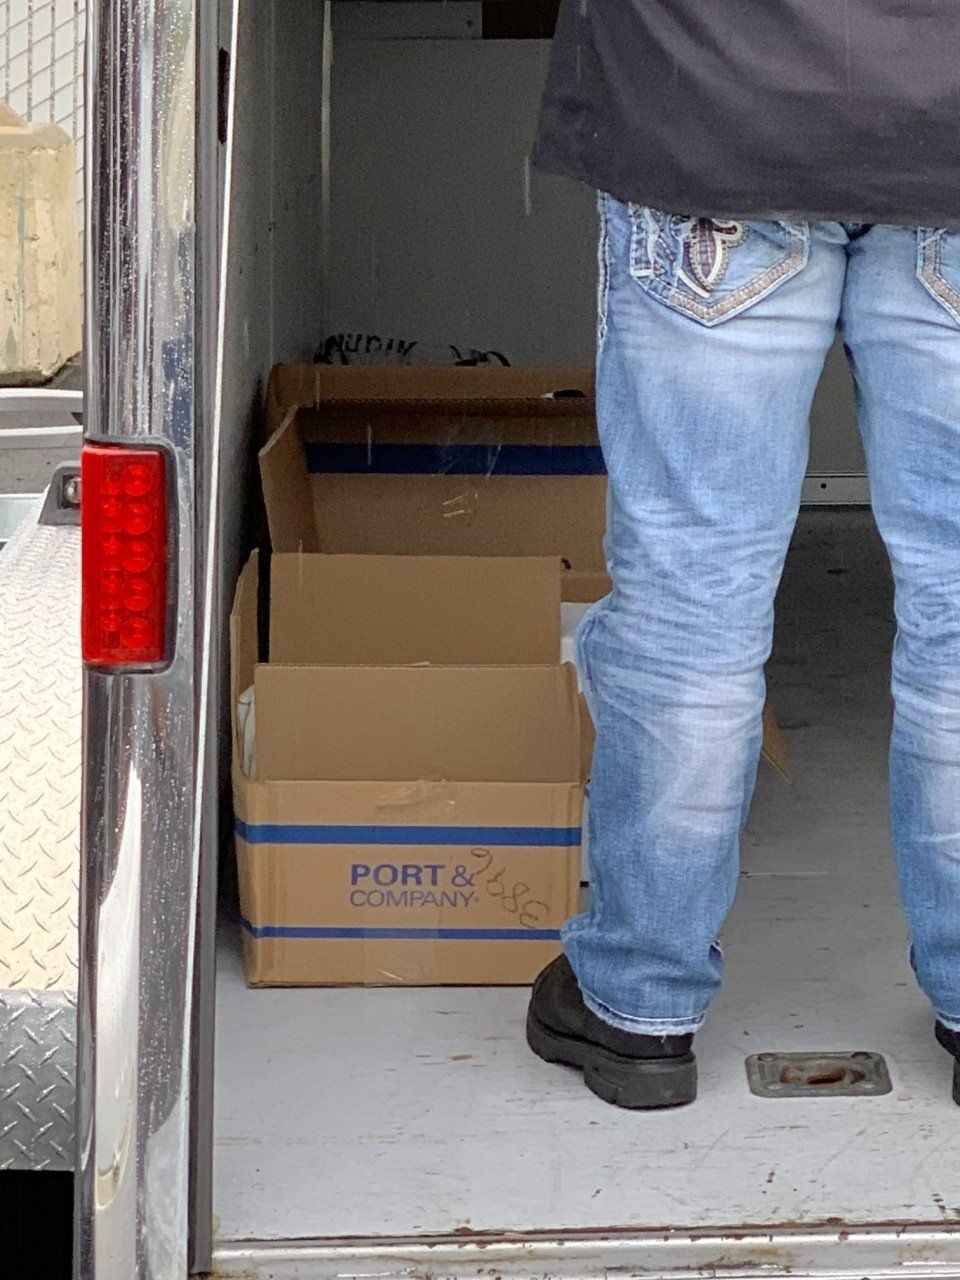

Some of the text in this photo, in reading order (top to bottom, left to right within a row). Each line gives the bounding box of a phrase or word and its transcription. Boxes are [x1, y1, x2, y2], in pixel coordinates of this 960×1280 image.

[351, 863, 476, 888] PORT &
[351, 889, 475, 908] COMPANY
